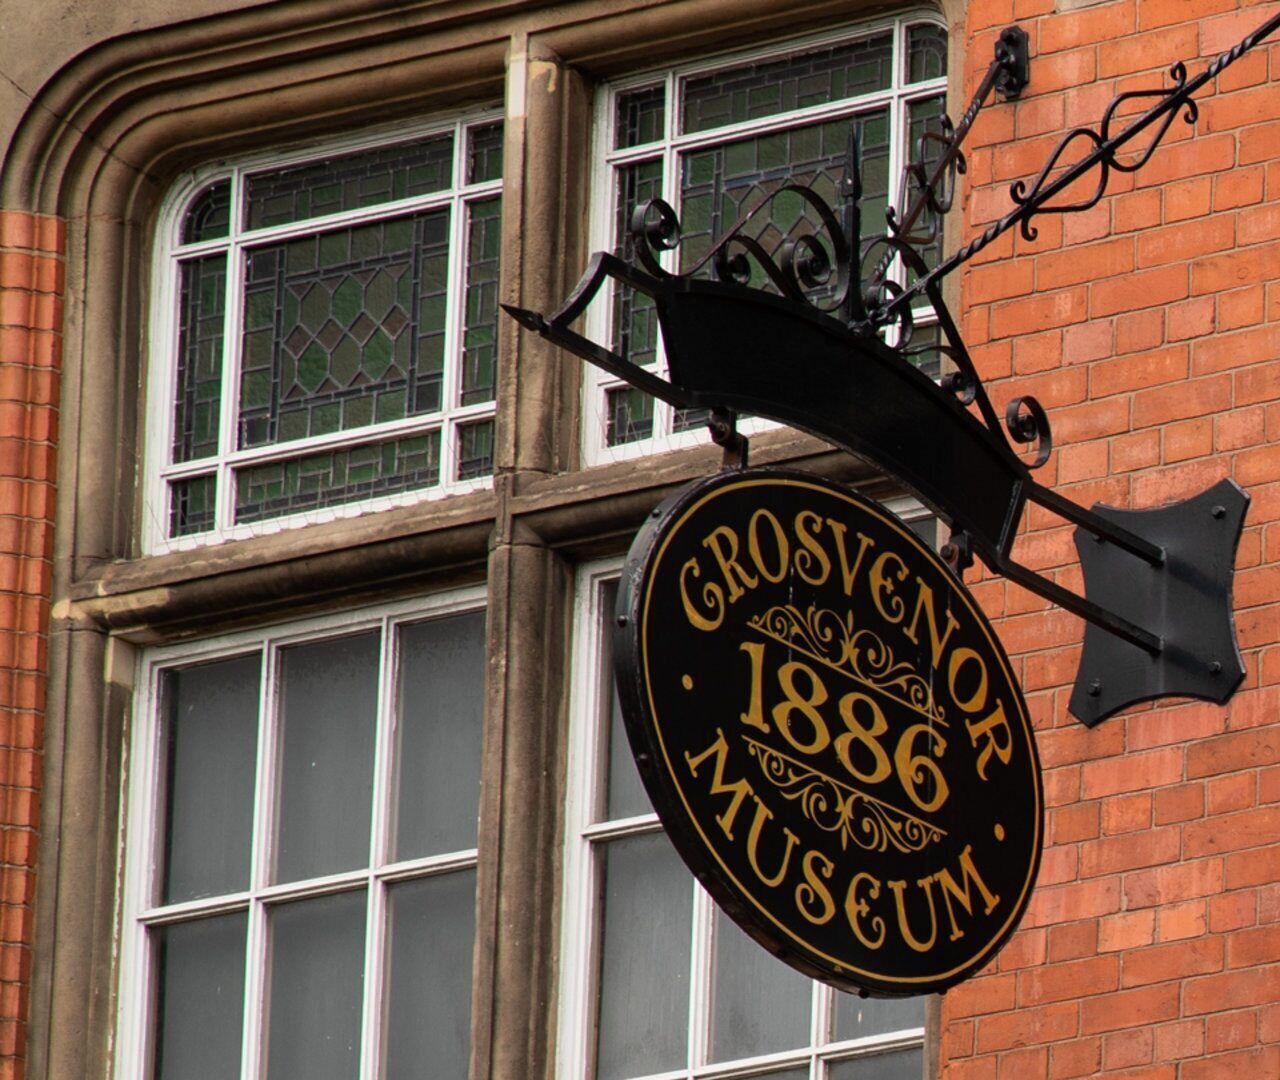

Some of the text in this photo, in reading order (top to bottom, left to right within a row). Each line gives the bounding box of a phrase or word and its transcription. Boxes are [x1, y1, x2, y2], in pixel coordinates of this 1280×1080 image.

[679, 508, 1014, 782] GROSVENOR
[739, 641, 951, 813] 1886
[684, 727, 1001, 953] MUSEUM
